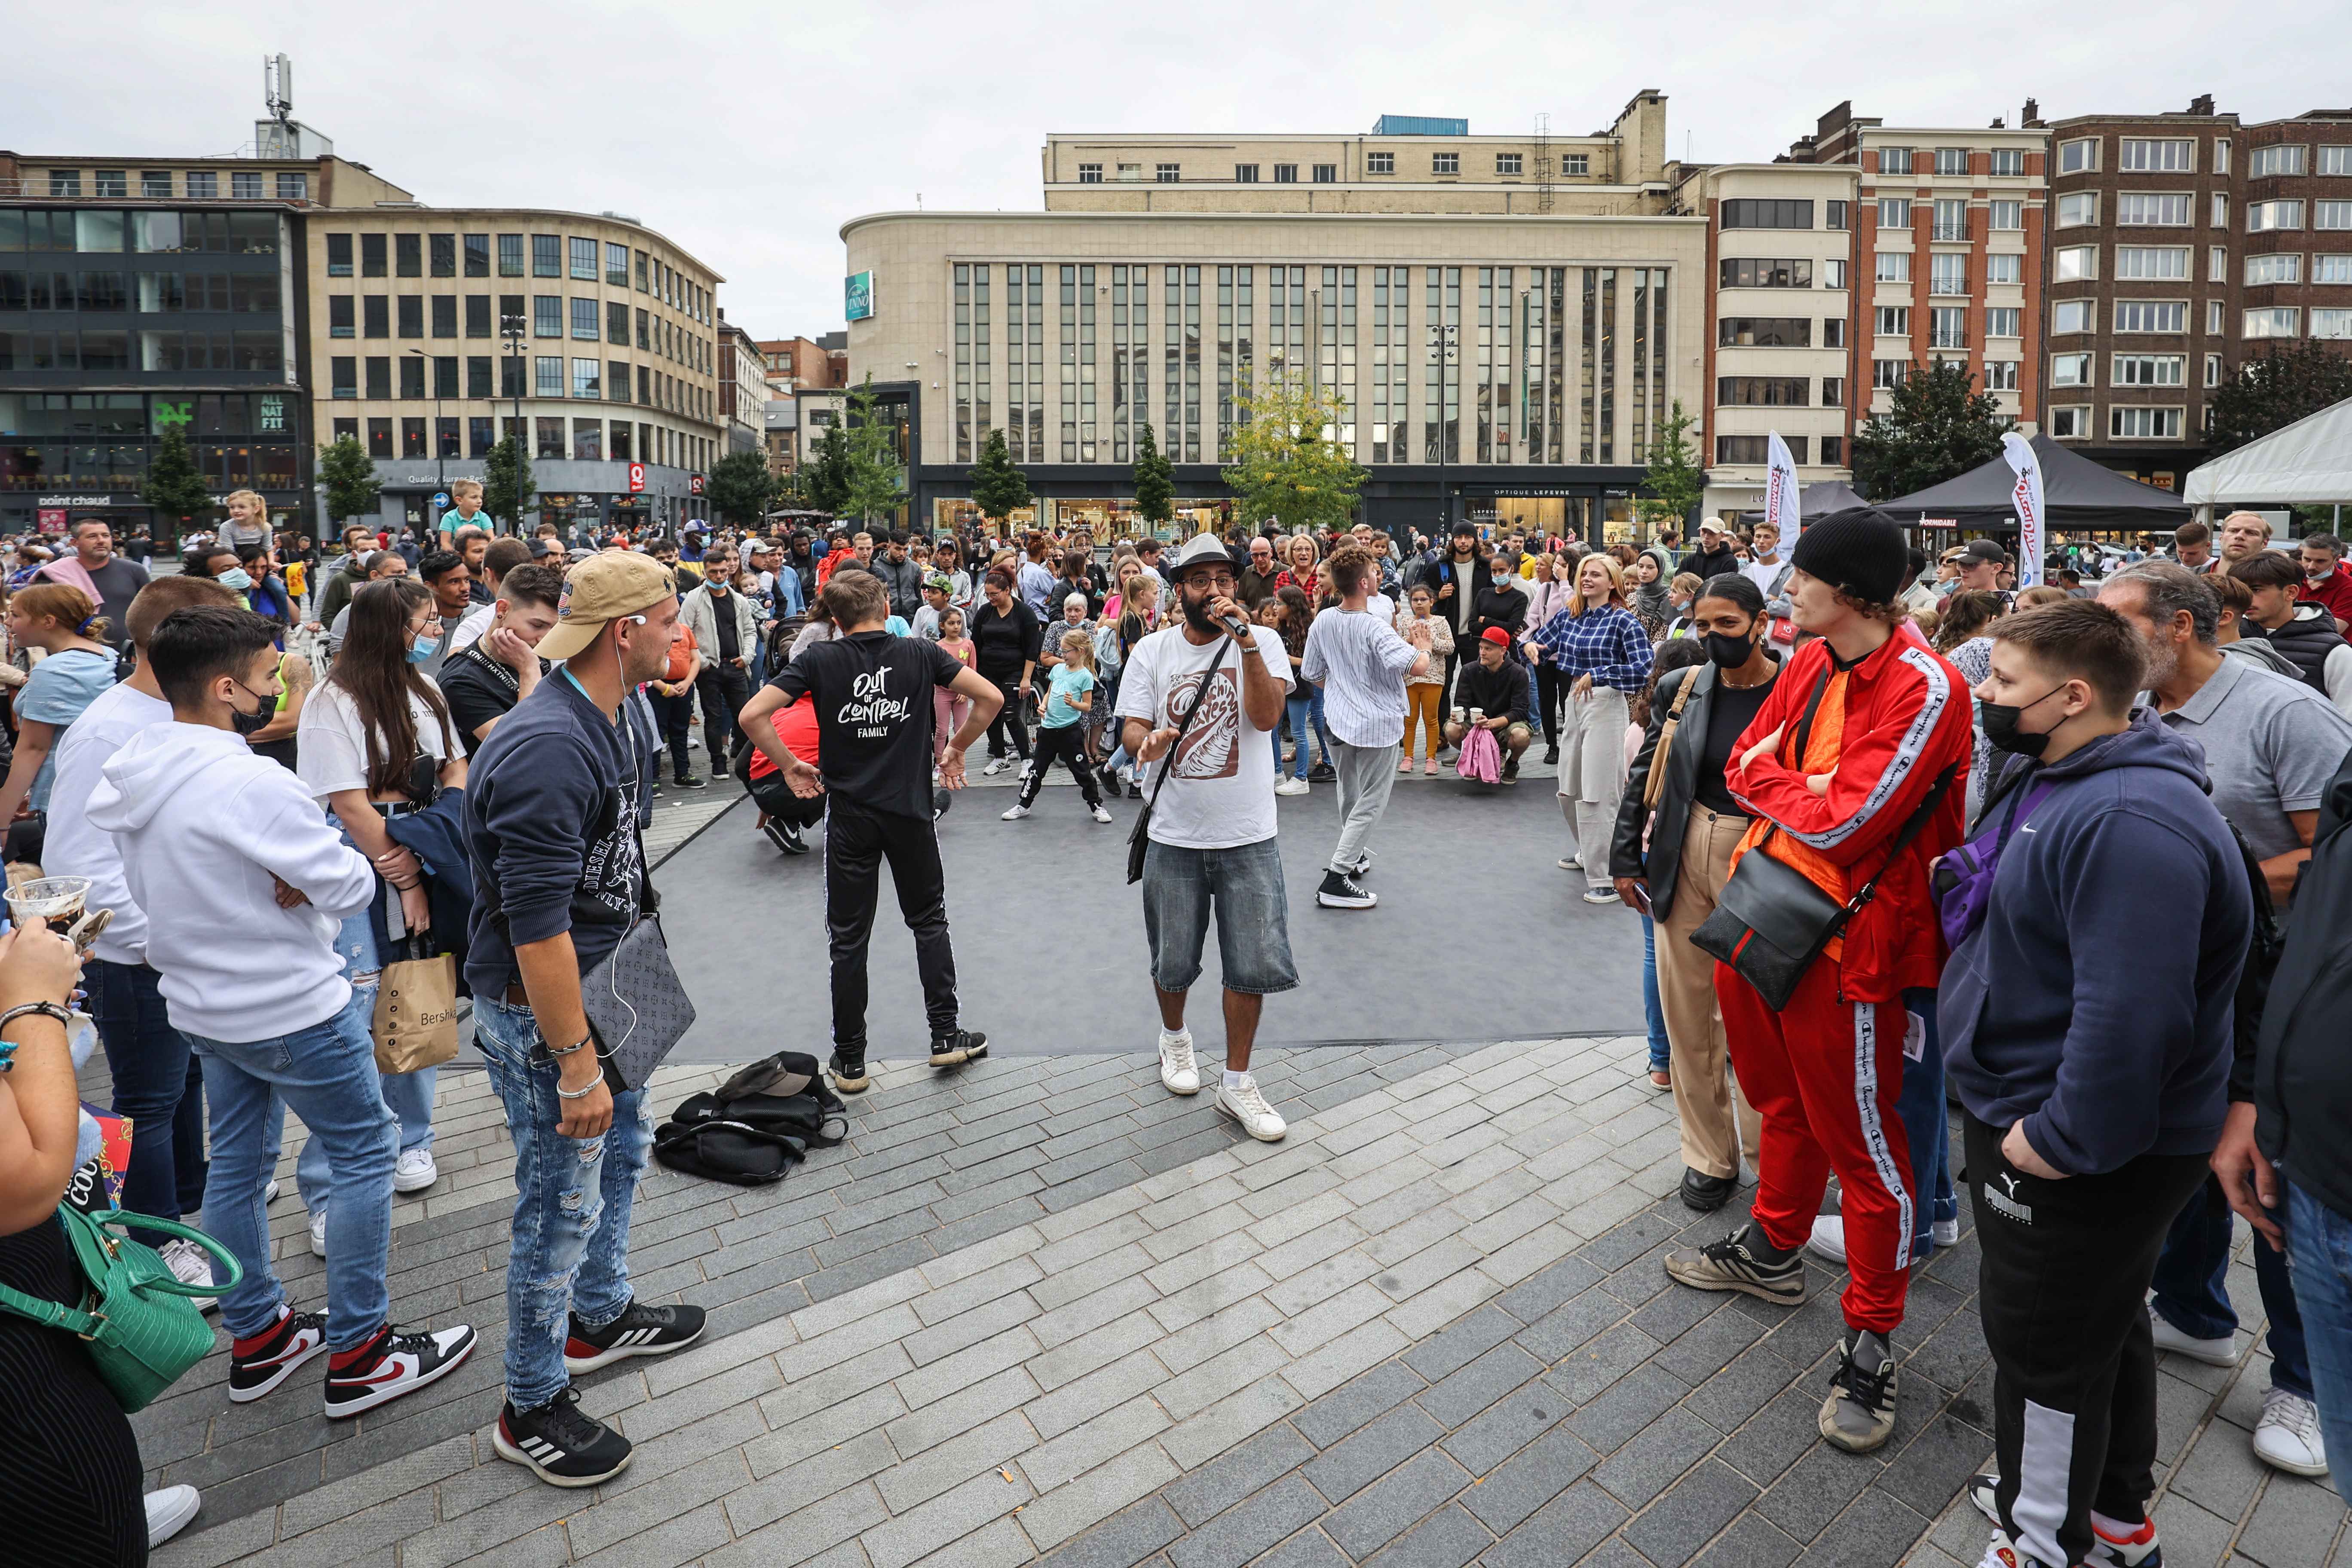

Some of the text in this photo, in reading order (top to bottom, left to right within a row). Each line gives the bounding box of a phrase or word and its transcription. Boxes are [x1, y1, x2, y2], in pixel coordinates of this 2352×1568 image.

[848, 295, 869, 310] INNO
[261, 394, 283, 405] ALL
[261, 406, 283, 416] NAT
[262, 417, 283, 429] FIT
[408, 475, 438, 484] Quality
[631, 466, 643, 484] Q
[39, 495, 110, 505] point chaud
[1770, 469, 1781, 524] FORMIDA
[467, 649, 506, 680] XTN HXTN
[864, 694, 873, 703] OF
[1908, 693, 1945, 747] Champion
[858, 726, 888, 738] FAMILY
[1871, 756, 1911, 808] Champion
[1809, 816, 1865, 845] Champion
[583, 839, 614, 890] DIESEL
[420, 1008, 456, 1026] Bershka
[1859, 1022, 1872, 1077] Champion
[1870, 1129, 1892, 1178] Champion
[70, 1161, 98, 1206] COU
[1984, 1182, 2032, 1222] PUMA
